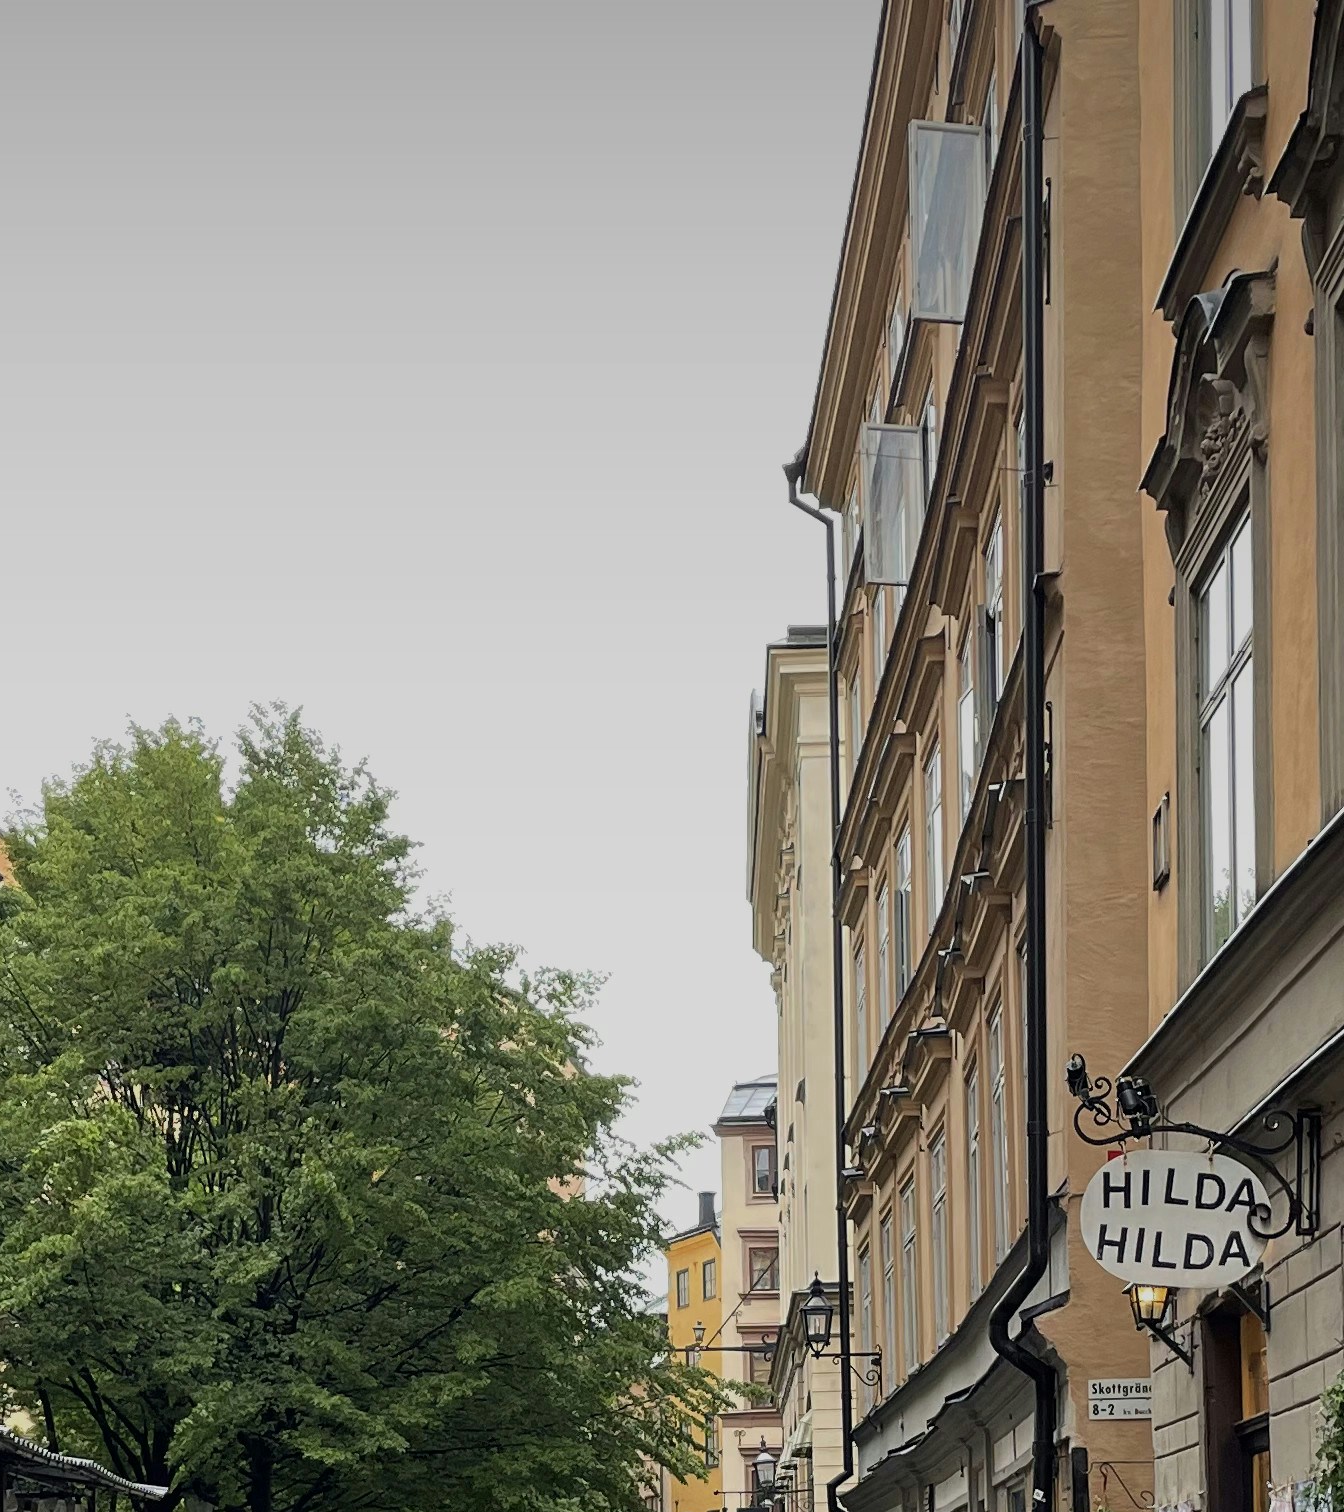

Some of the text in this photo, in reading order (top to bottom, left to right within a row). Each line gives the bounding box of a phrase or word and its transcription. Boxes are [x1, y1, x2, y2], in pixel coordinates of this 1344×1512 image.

[1101, 1167, 1258, 1214] HILDA
[1096, 1223, 1251, 1271] HILDA
[1092, 1403, 1115, 1416] 8-2
